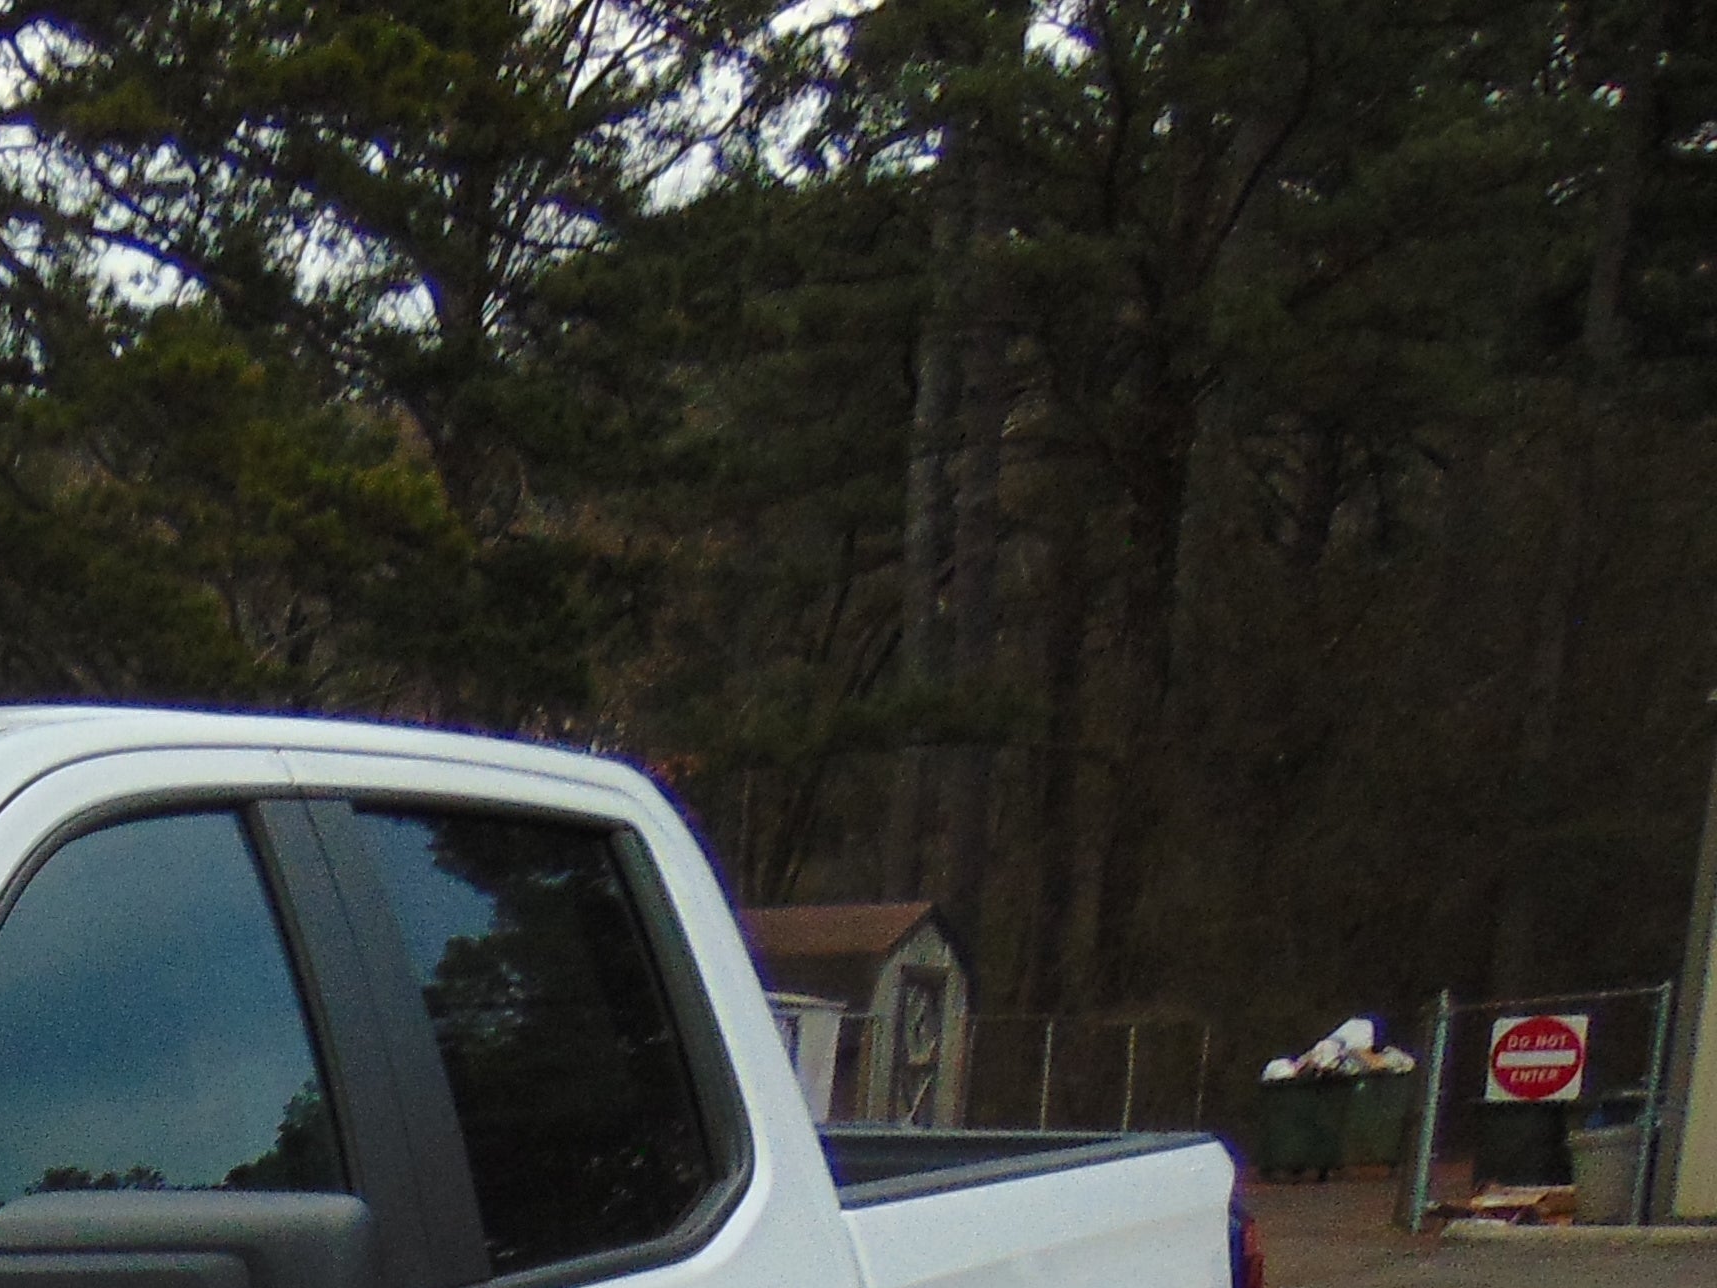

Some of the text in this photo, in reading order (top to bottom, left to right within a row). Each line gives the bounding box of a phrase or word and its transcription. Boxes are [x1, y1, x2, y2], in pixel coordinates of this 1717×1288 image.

[1507, 1033, 1569, 1049] DO NOT
[1510, 1068, 1559, 1083] ENTER
